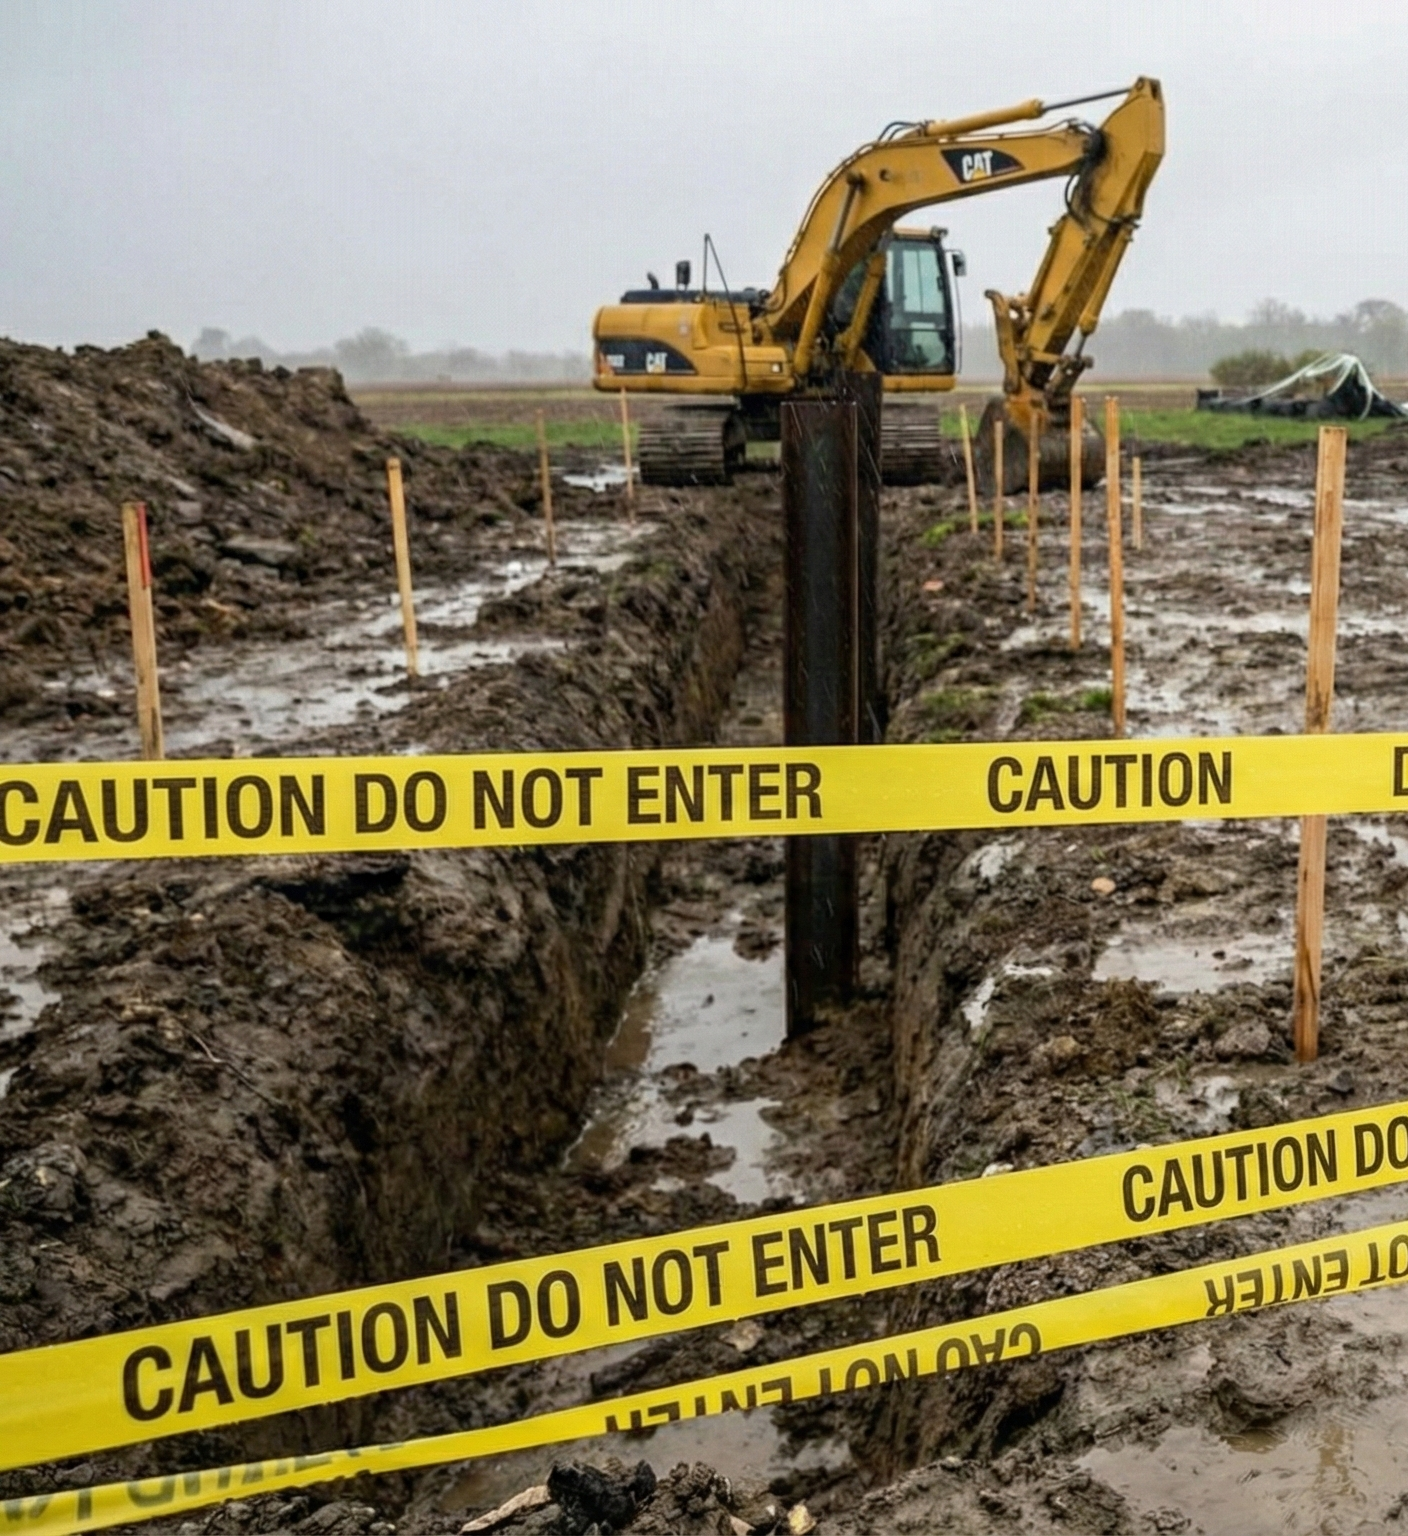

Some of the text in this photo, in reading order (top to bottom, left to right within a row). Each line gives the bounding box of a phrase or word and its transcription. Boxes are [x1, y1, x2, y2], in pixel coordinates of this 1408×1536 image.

[962, 150, 993, 181] CAT
[0, 774, 325, 845] CAUTION
[355, 771, 447, 834] DO
[473, 767, 602, 829] NOT
[627, 762, 823, 825] ENTER
[987, 752, 1232, 813] CAUTION
[122, 1291, 462, 1422] CAUTION
[487, 1270, 581, 1350] DO
[604, 1241, 729, 1327] NOT
[752, 1204, 942, 1297] ENTER
[1122, 1129, 1338, 1222] CAUTION
[1204, 1250, 1349, 1317] ENTER
